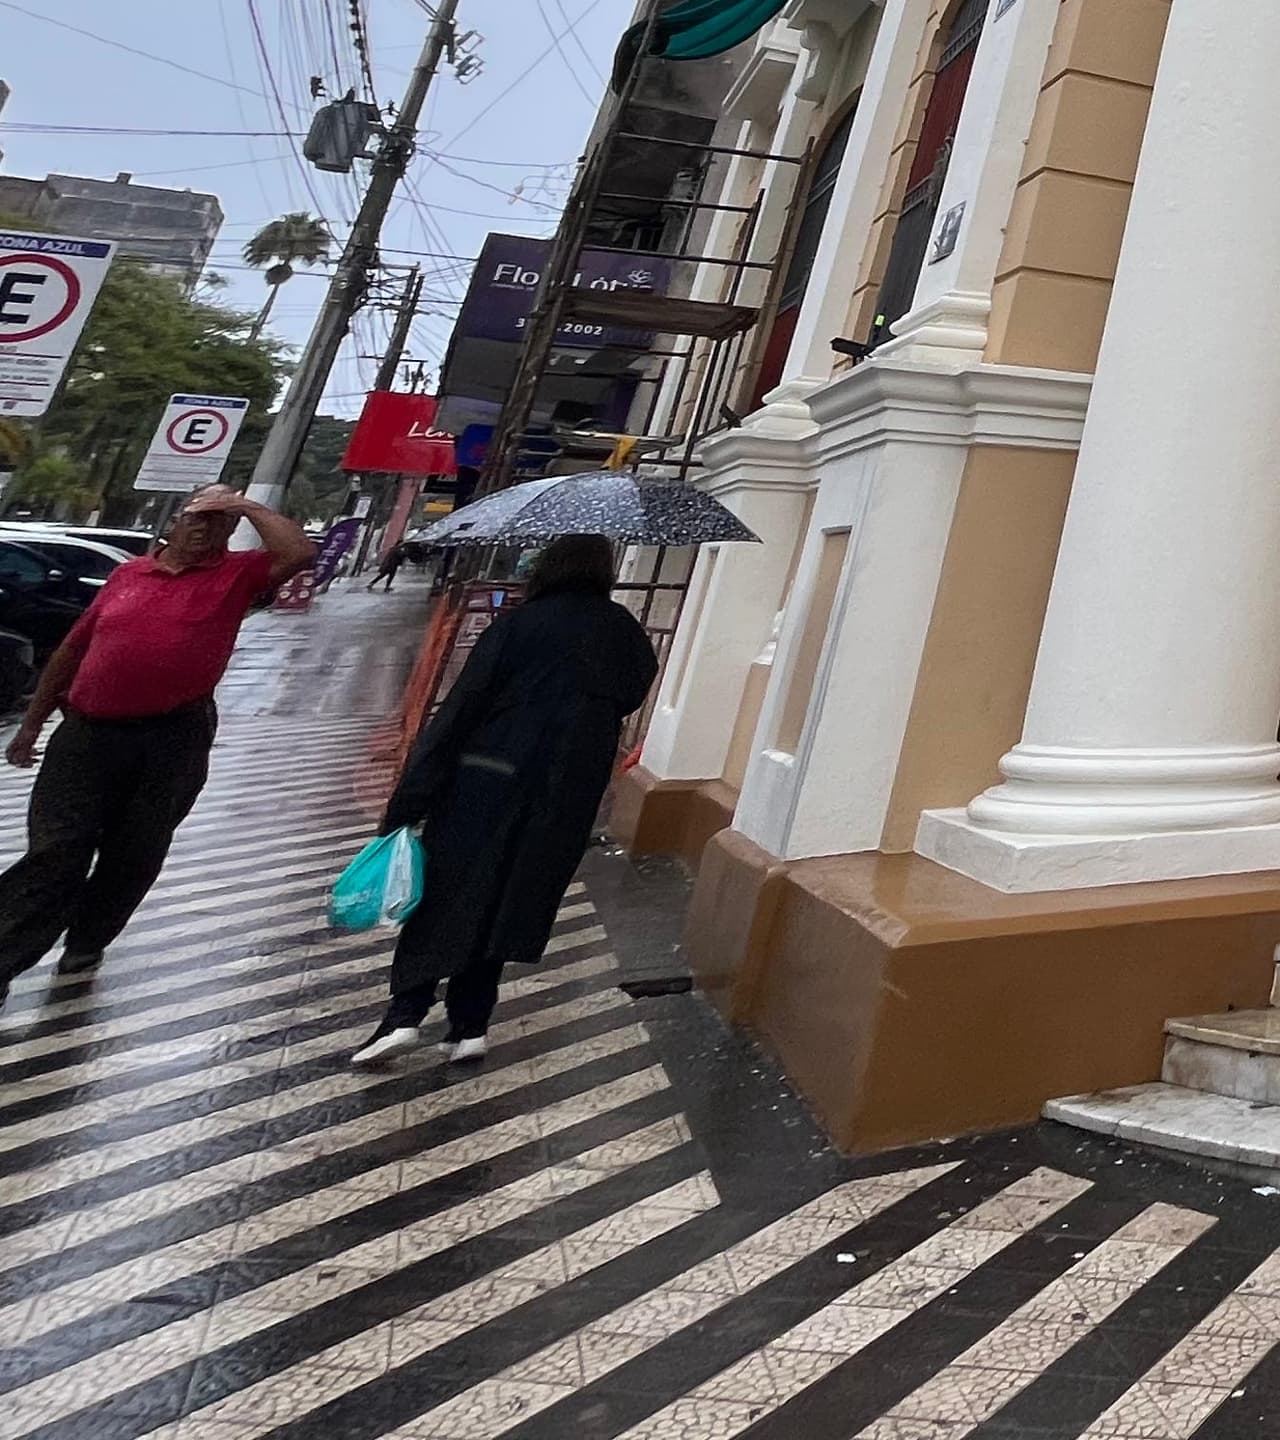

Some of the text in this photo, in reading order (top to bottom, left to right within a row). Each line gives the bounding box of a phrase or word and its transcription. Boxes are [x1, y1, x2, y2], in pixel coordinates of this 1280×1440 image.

[42, 241, 85, 254] AZUL
[0, 272, 48, 324] E
[182, 419, 213, 444] E
